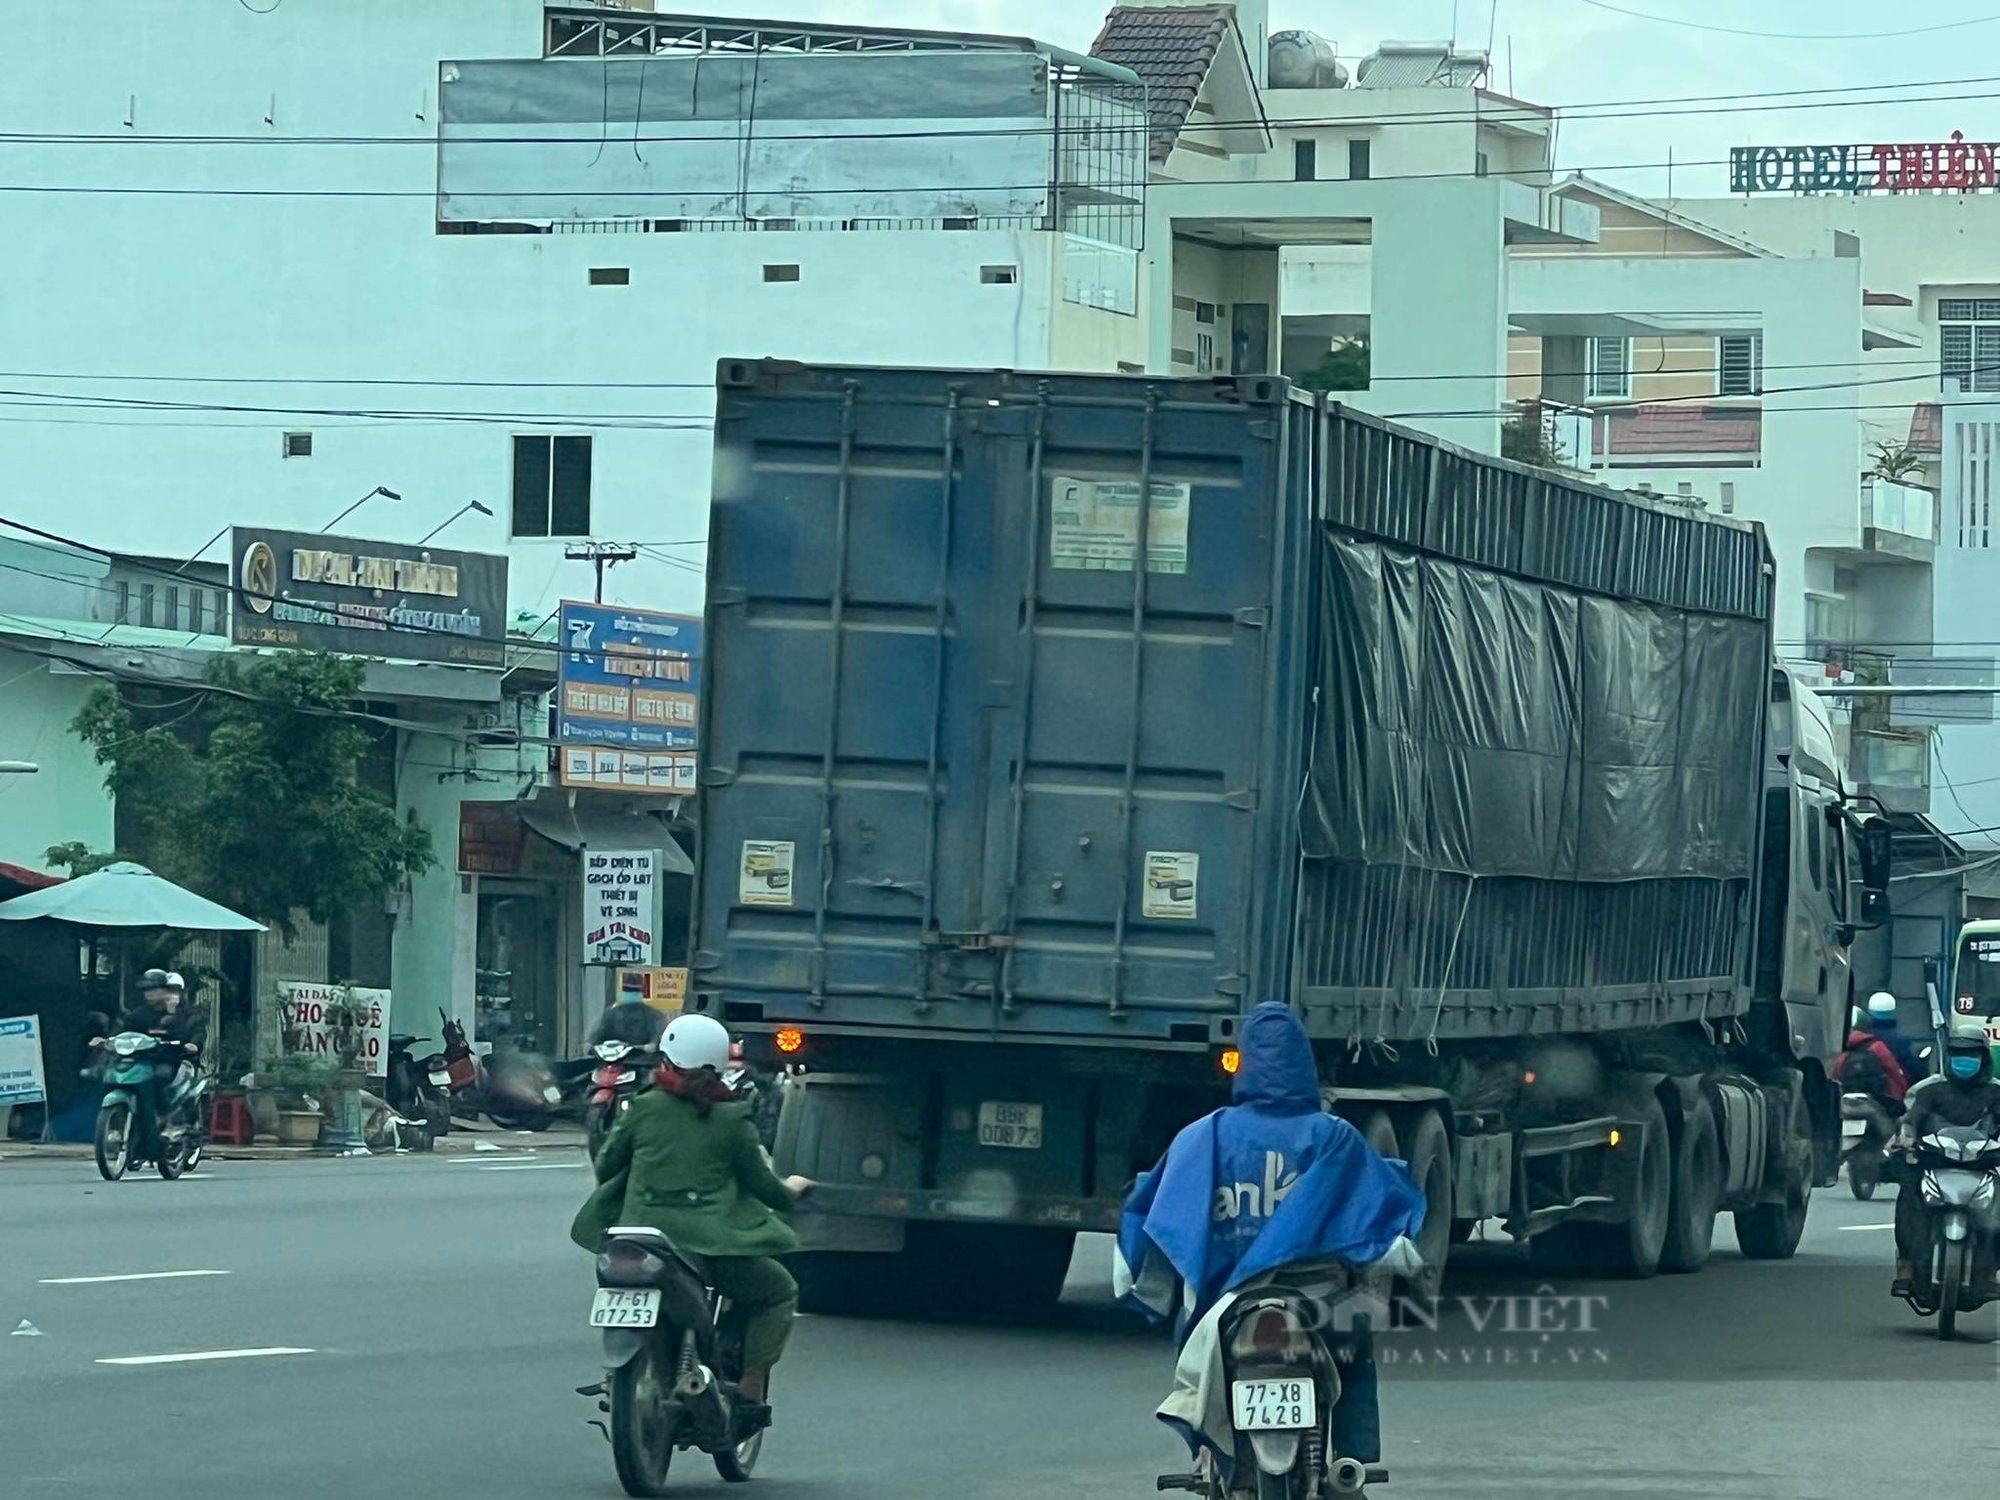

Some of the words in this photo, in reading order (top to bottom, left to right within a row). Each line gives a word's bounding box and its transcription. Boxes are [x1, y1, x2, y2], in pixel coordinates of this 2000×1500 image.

[1732, 145, 1859, 192] HOTEL
[607, 1291, 650, 1306] 77-G1
[1245, 1384, 1301, 1404] 77-X8
[1246, 1406, 1301, 1426] 7428
